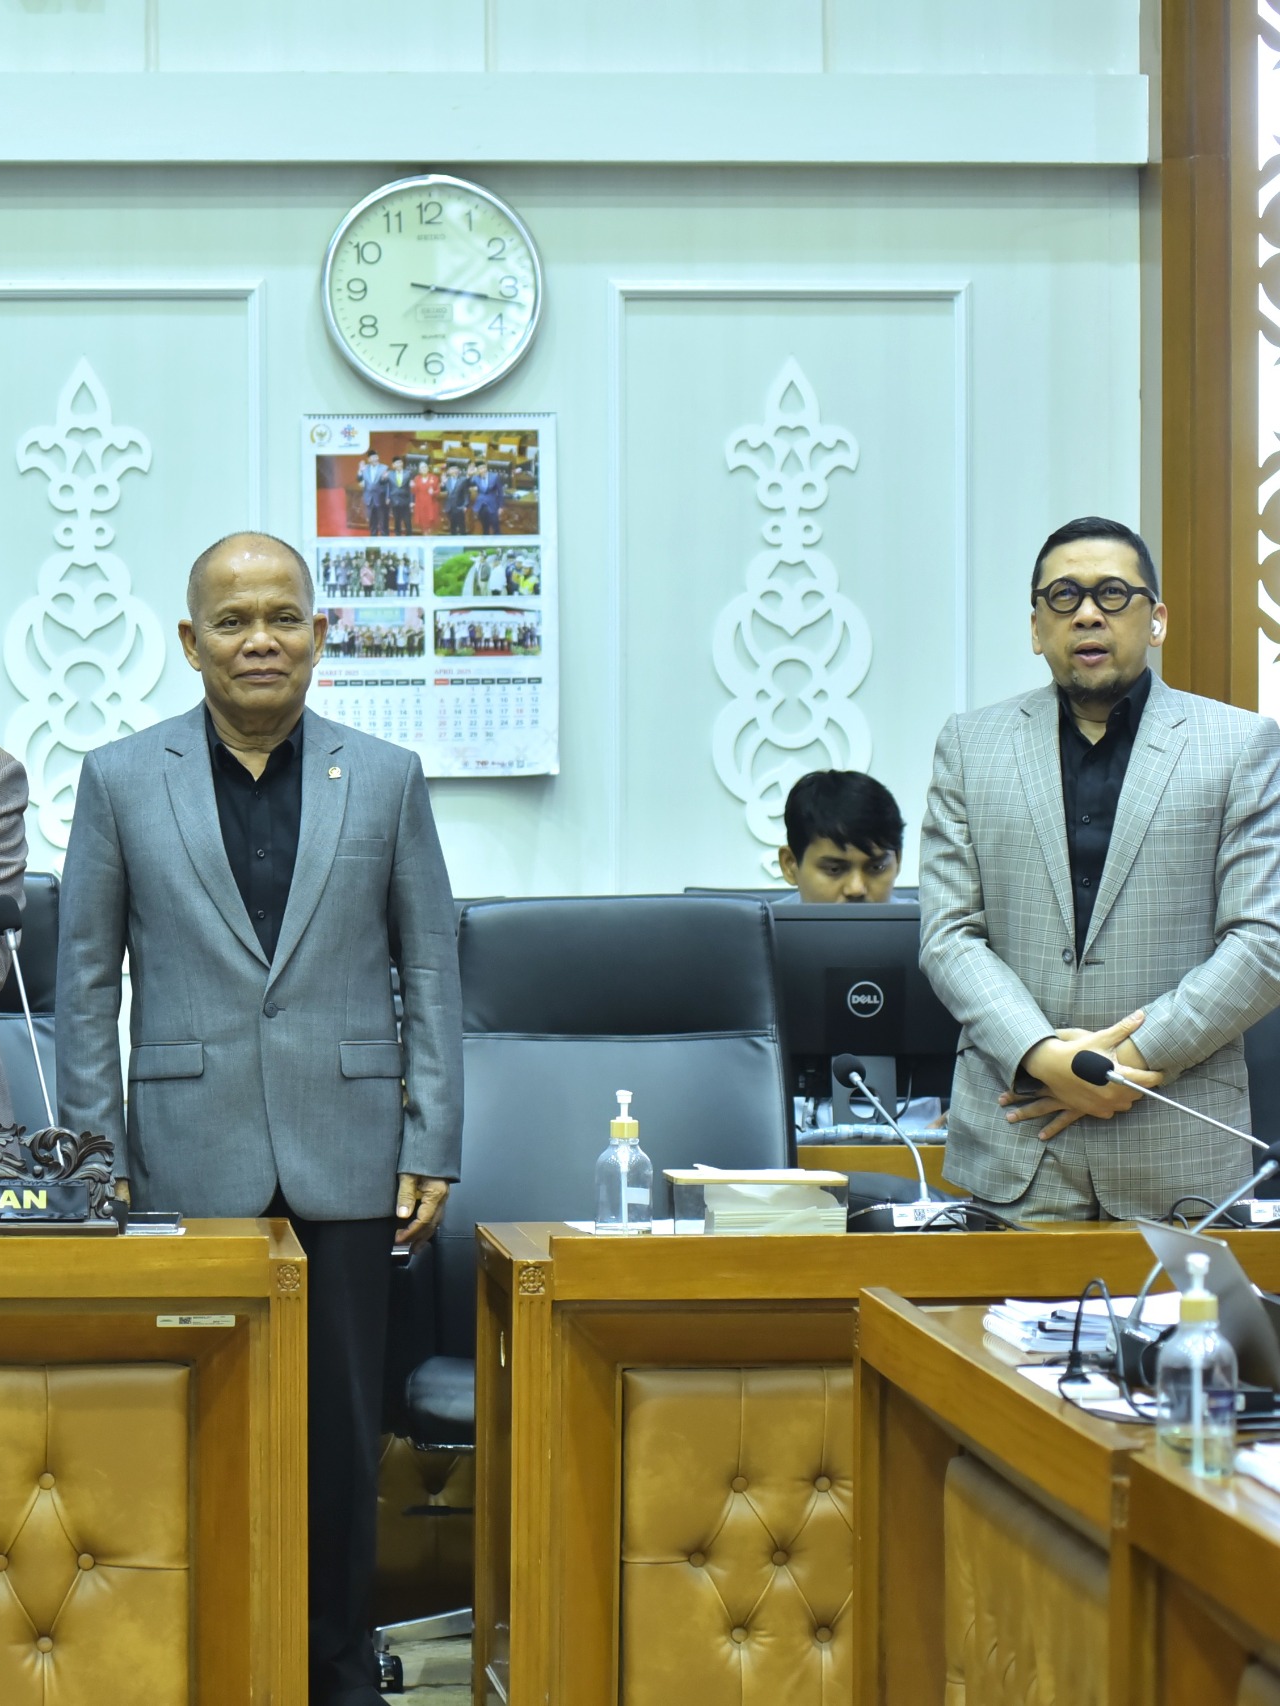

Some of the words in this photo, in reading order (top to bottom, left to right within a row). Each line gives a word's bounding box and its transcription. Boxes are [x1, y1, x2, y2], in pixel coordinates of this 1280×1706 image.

[384, 211, 402, 233] 11
[417, 202, 443, 224] 12
[466, 210, 472, 232] 1
[354, 241, 382, 264] 10
[488, 238, 506, 260] 2
[346, 278, 367, 301] 9
[499, 276, 518, 298] 3
[359, 315, 378, 338] 8
[488, 312, 506, 336] 4
[390, 343, 408, 366] 7
[424, 352, 444, 375] 6
[462, 342, 481, 365] 5
[852, 994, 880, 1004] DELL
